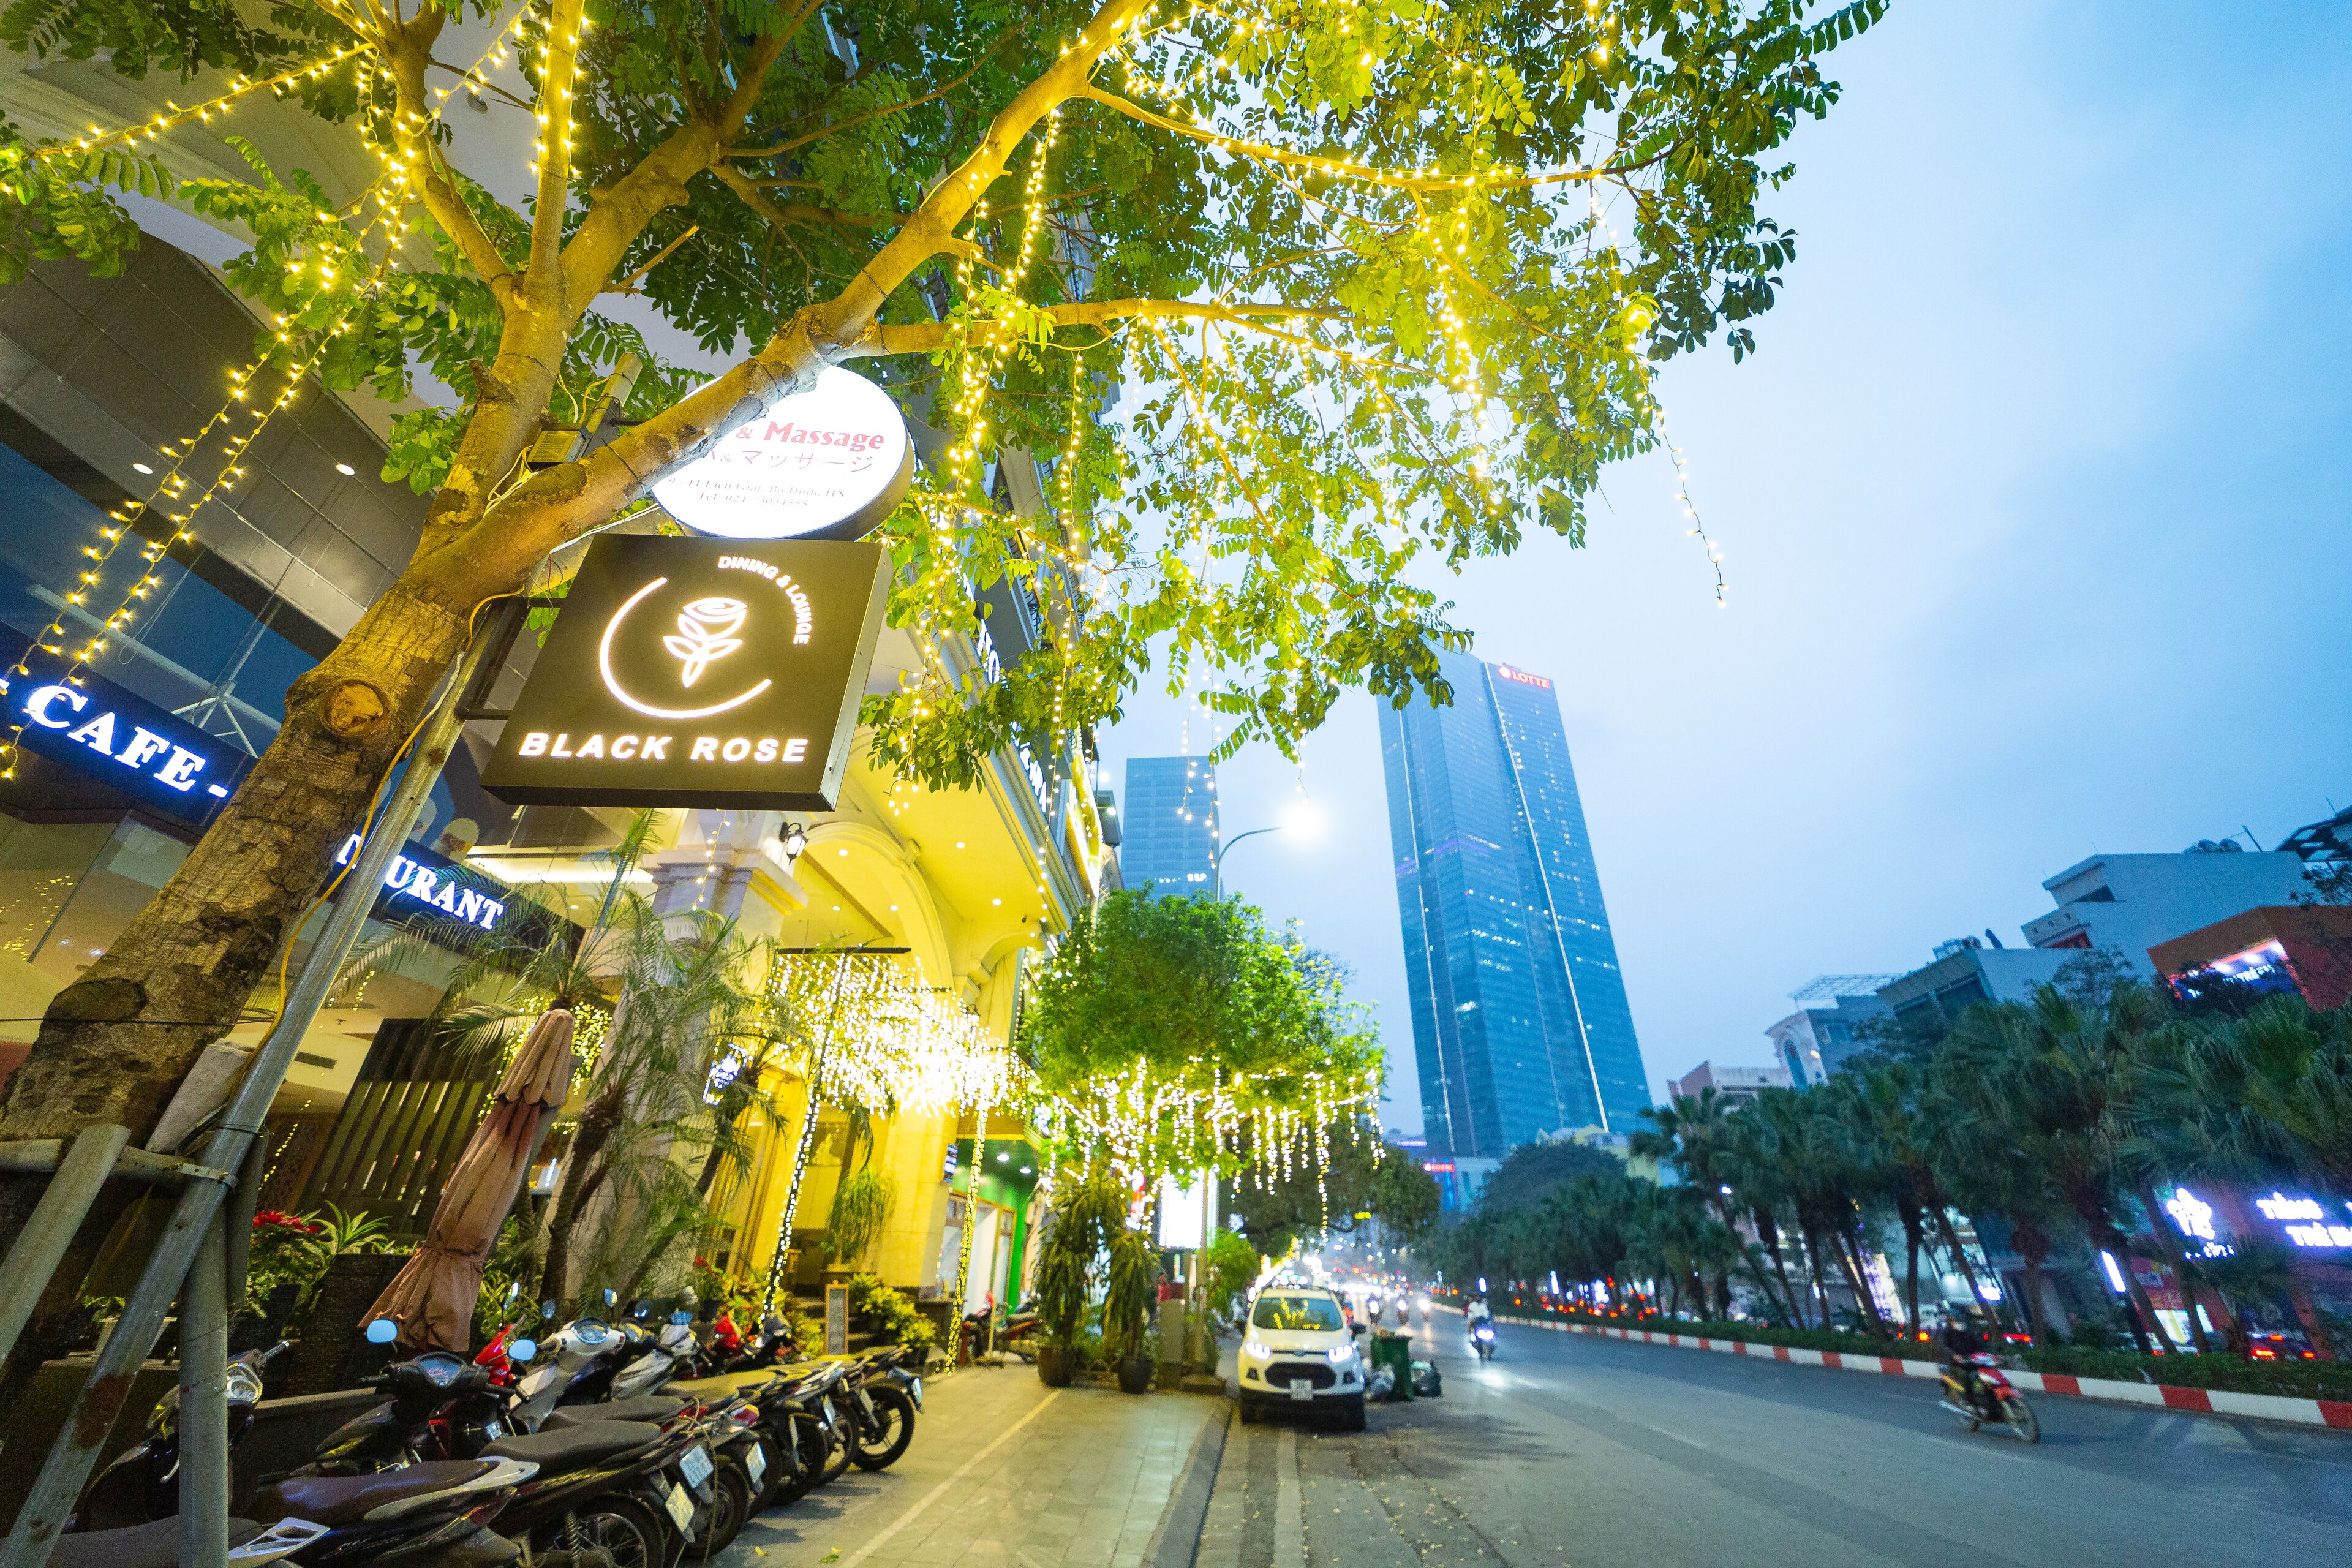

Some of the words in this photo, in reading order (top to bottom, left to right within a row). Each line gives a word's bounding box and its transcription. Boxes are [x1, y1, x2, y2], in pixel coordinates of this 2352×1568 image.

[736, 427, 752, 439] &
[764, 421, 884, 452] Massage
[742, 450, 873, 472] マッサージ
[718, 556, 778, 579] DINING
[776, 575, 791, 588] &
[786, 584, 812, 644] LOUNGE
[1512, 671, 1550, 688] LOTTE
[28, 685, 206, 792] CAFE
[519, 733, 671, 760] BLACK
[690, 737, 809, 762] ROSE
